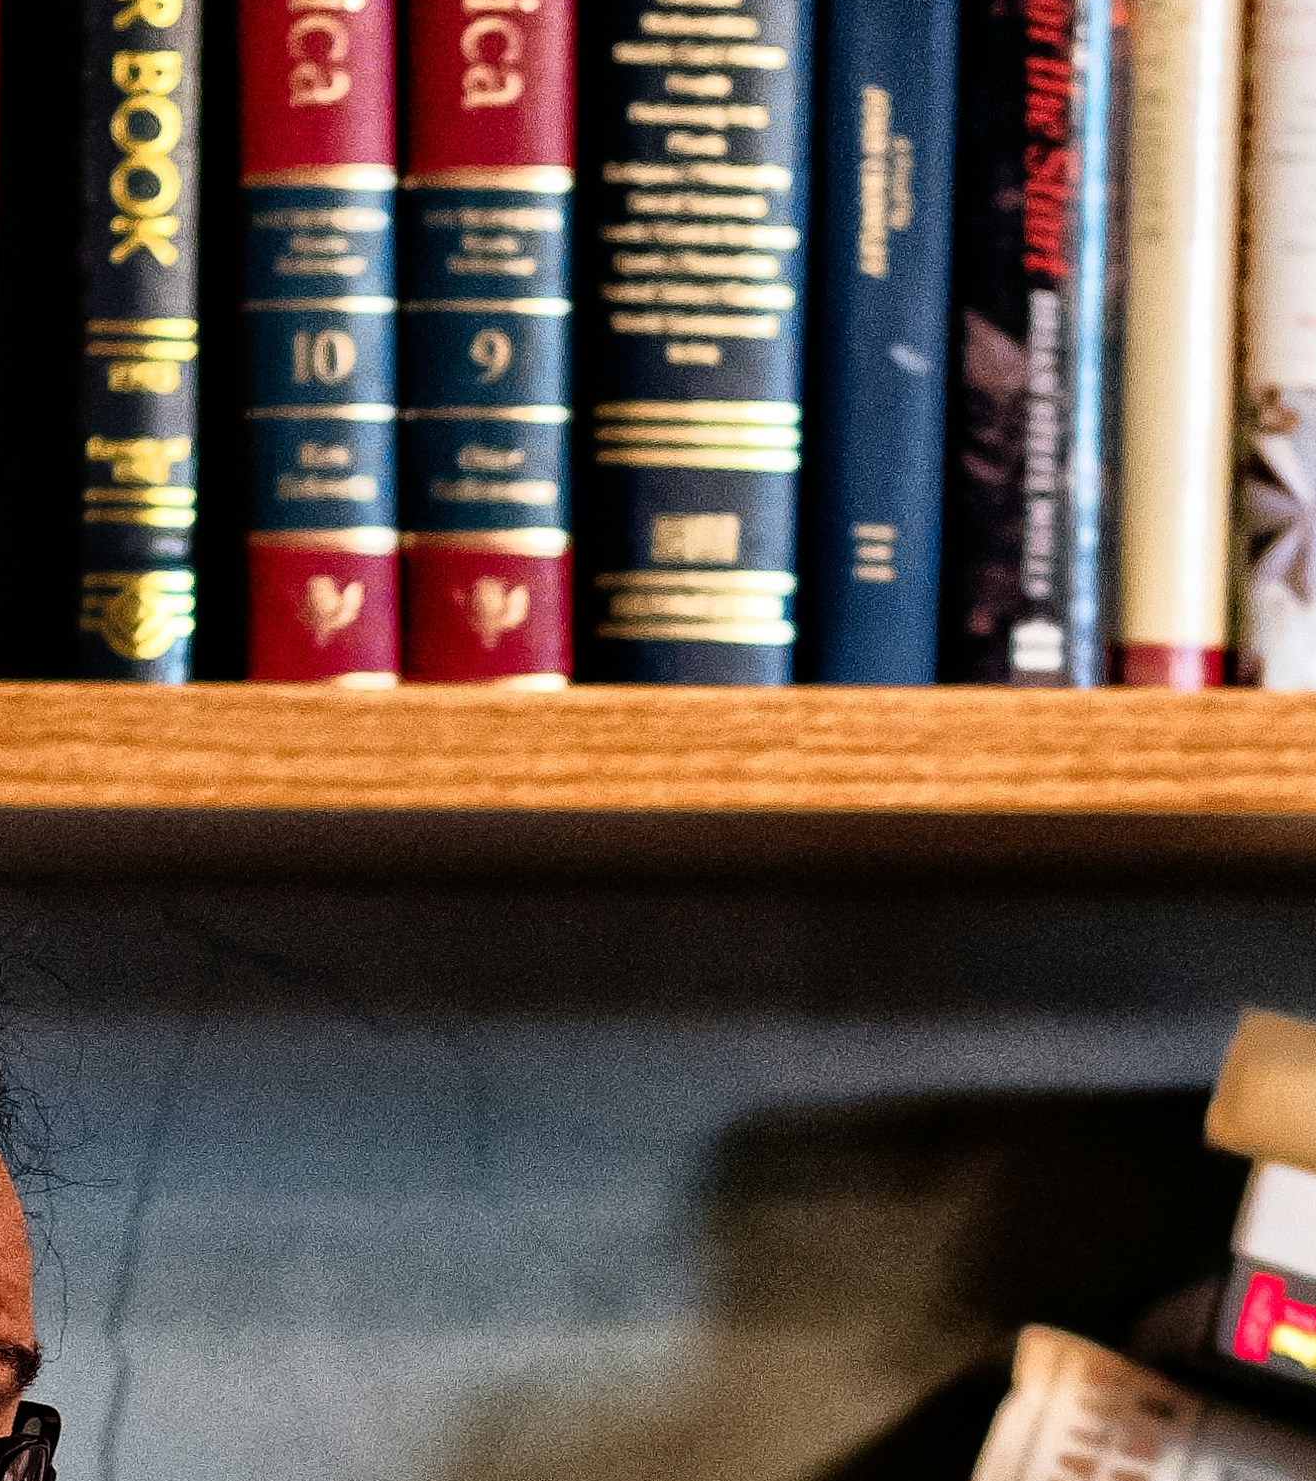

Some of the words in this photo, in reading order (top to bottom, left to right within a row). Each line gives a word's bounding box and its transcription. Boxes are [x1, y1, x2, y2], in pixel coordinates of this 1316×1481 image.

[107, 46, 184, 268] BOOK
[1022, 144, 1079, 278] Start
[291, 328, 357, 386] 10
[469, 328, 514, 385] 9
